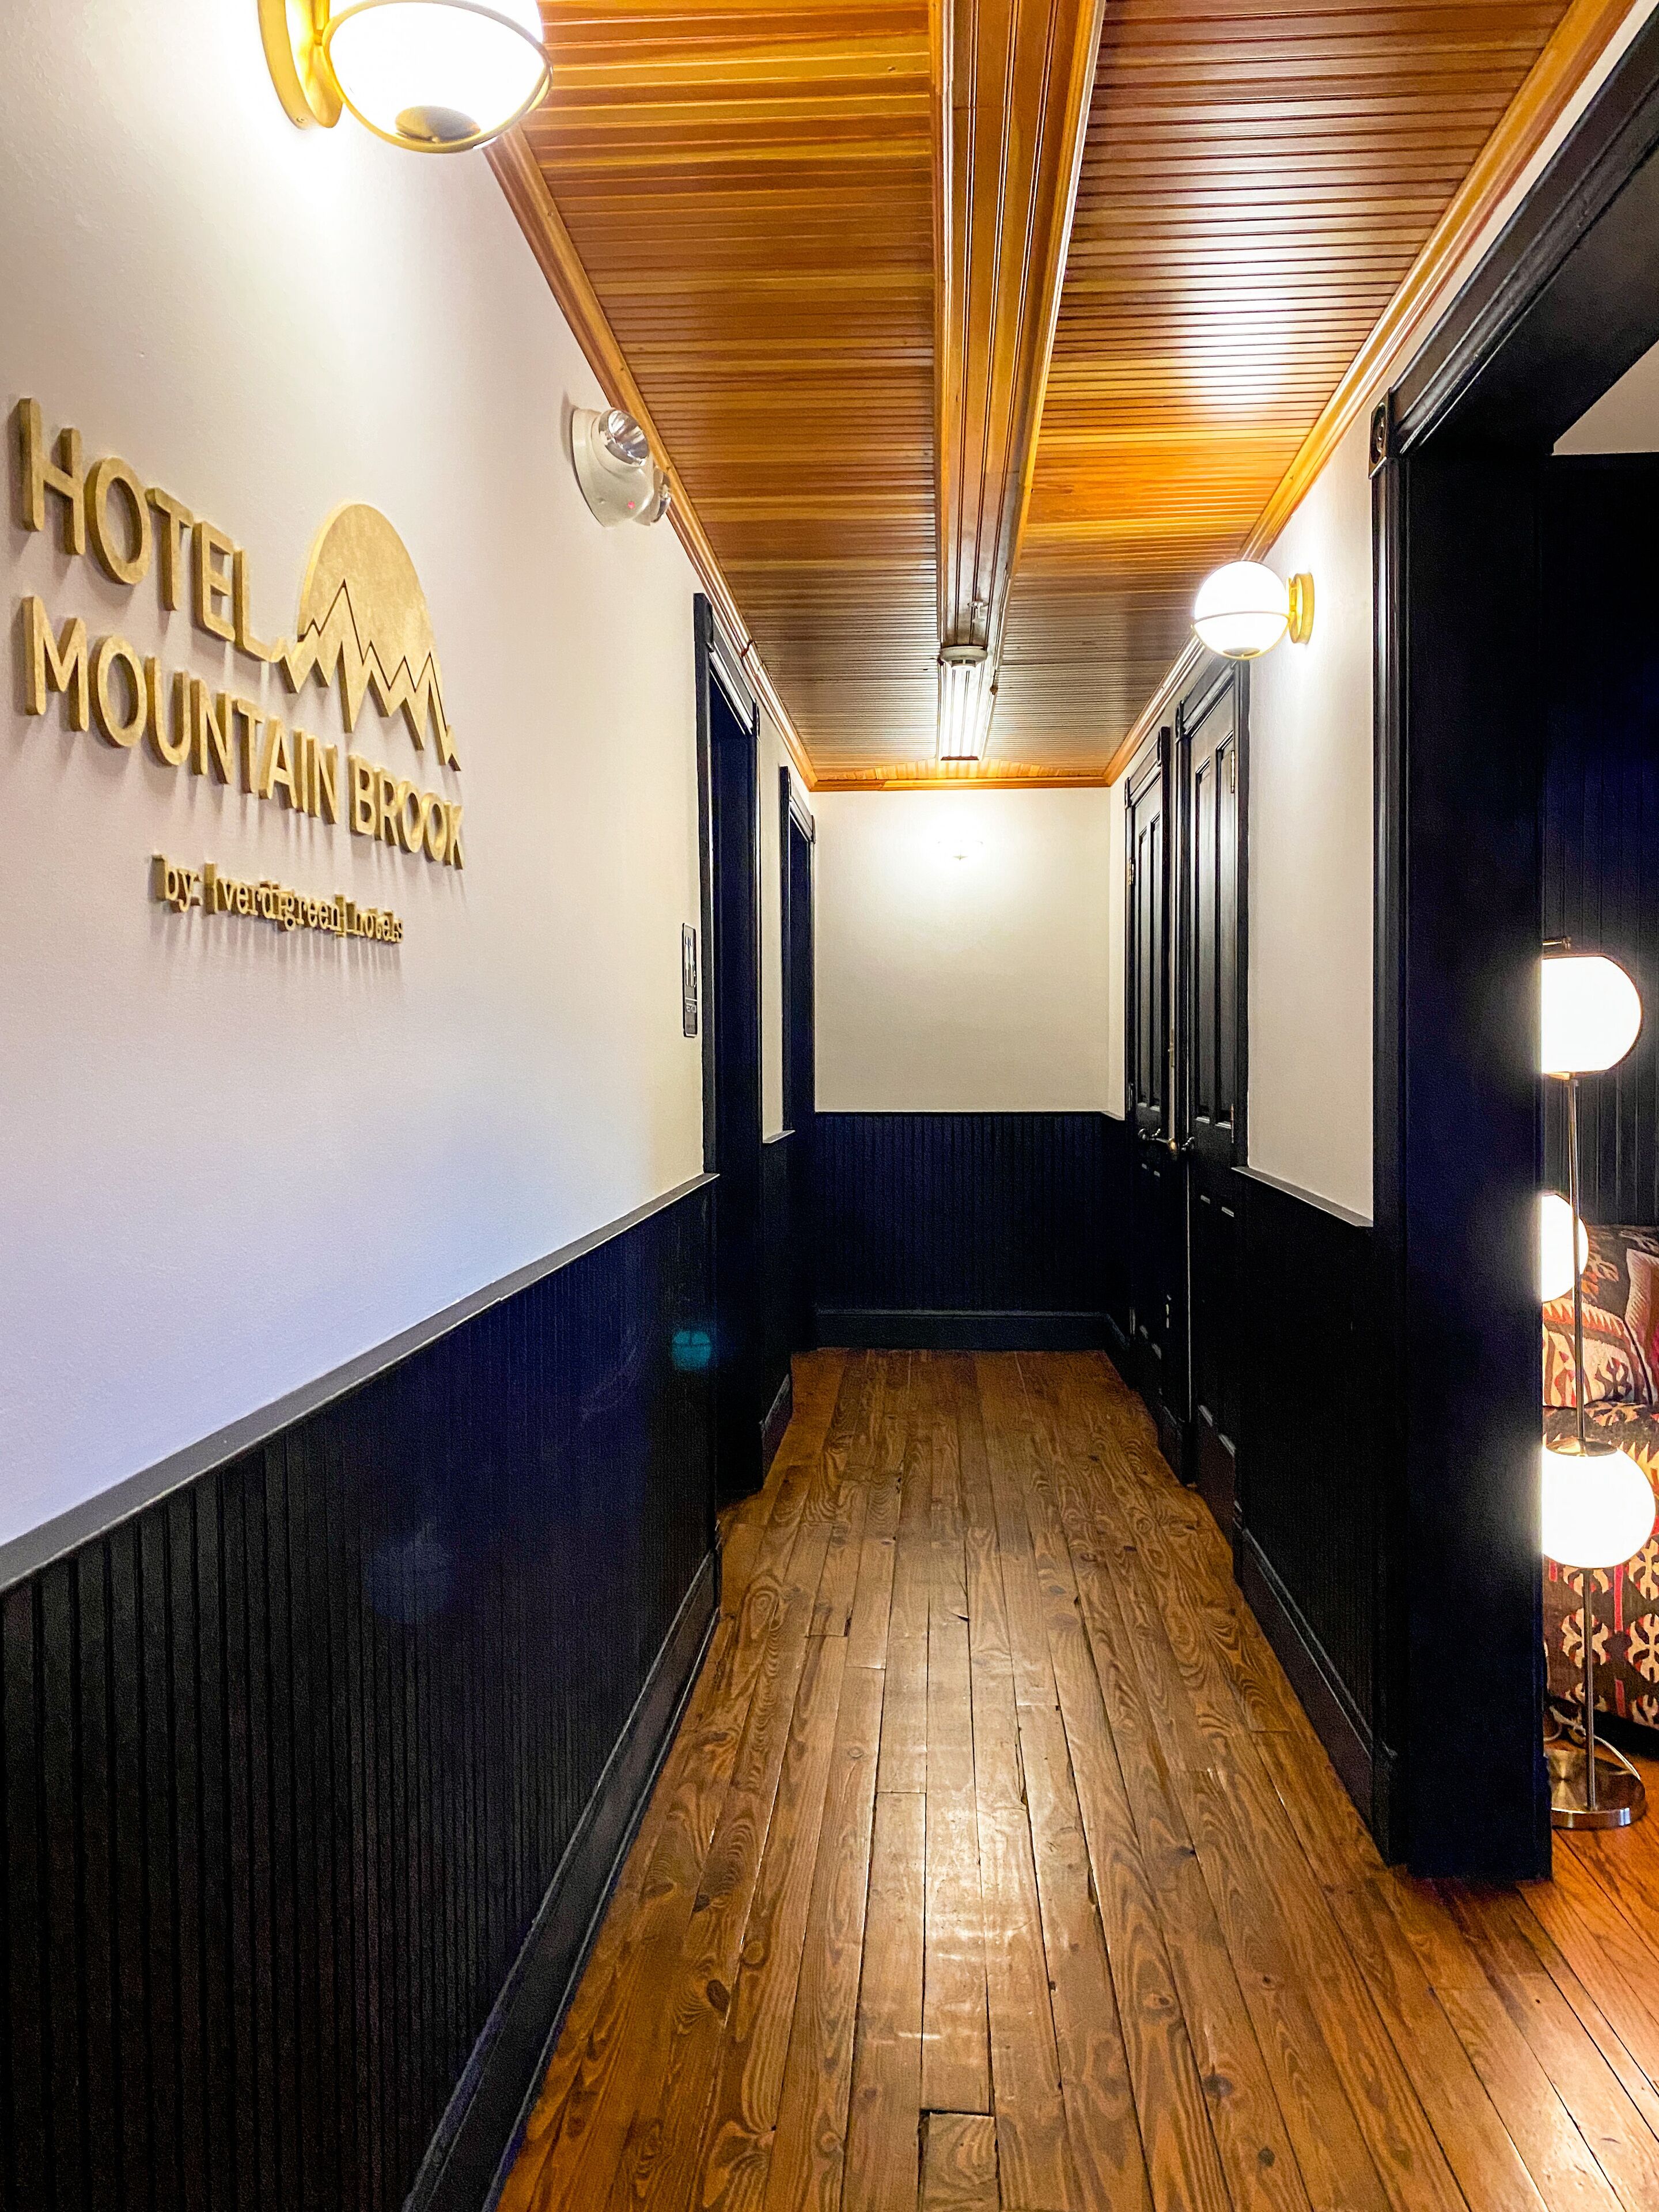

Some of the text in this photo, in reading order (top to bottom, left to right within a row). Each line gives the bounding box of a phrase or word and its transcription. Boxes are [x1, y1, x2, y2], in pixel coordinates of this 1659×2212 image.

[19, 397, 282, 662] HOTEL
[22, 596, 463, 870] MOUNTAIN BROOK
[346, 900, 403, 944] hotels
